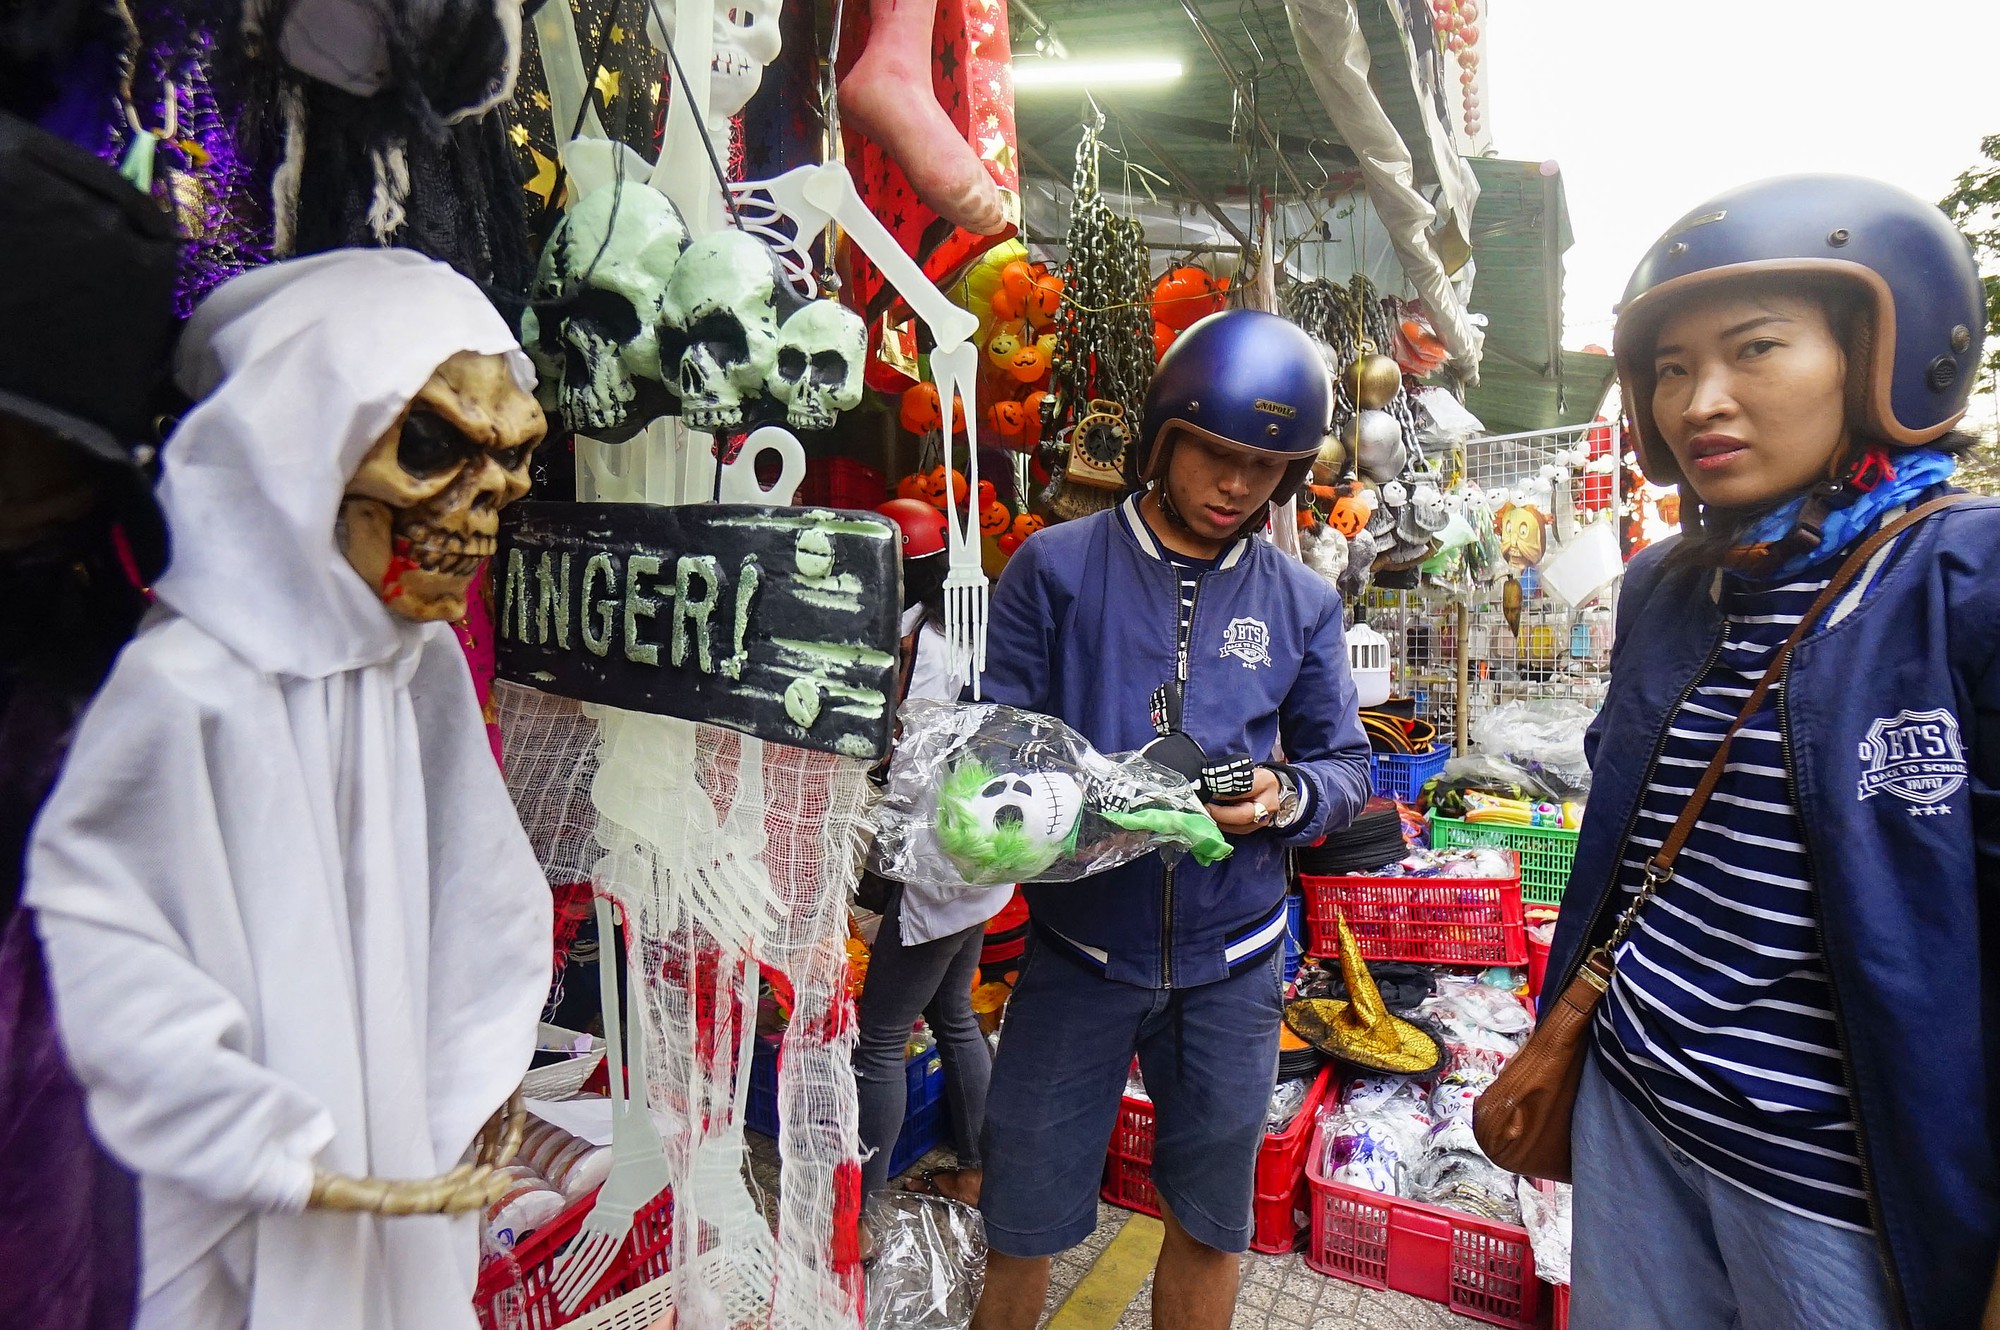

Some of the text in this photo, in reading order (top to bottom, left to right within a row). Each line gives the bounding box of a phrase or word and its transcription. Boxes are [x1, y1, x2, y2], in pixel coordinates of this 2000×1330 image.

[1260, 402, 1291, 415] NAPOLI
[1237, 625, 1261, 643] BTS
[1886, 725, 1946, 760] BTS
[1868, 763, 1968, 784] BACK TO SCHOOL
